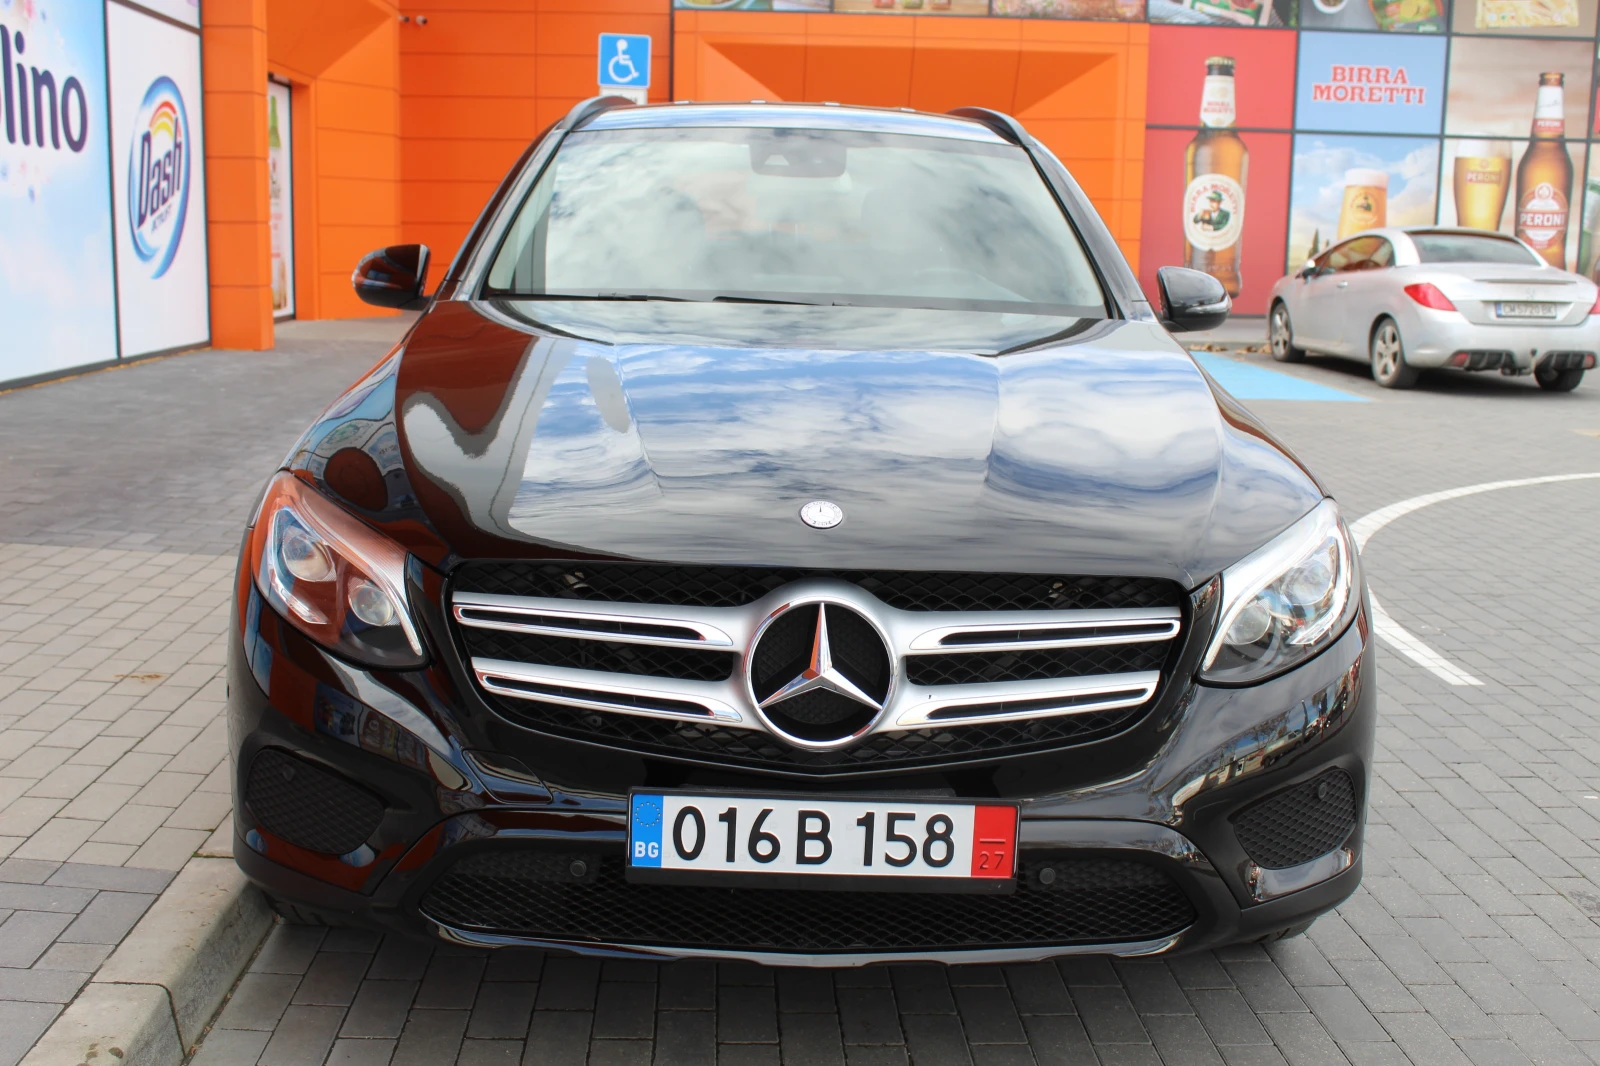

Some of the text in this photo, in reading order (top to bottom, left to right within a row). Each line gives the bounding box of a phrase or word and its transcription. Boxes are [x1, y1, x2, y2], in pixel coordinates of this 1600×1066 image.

[1331, 65, 1408, 84] BIRRA
[0, 23, 88, 153] lino
[1312, 84, 1425, 104] MORETTI
[136, 115, 183, 229] Dash
[1519, 212, 1565, 226] PERONI
[633, 840, 660, 858] BG
[979, 850, 1005, 870] 27
